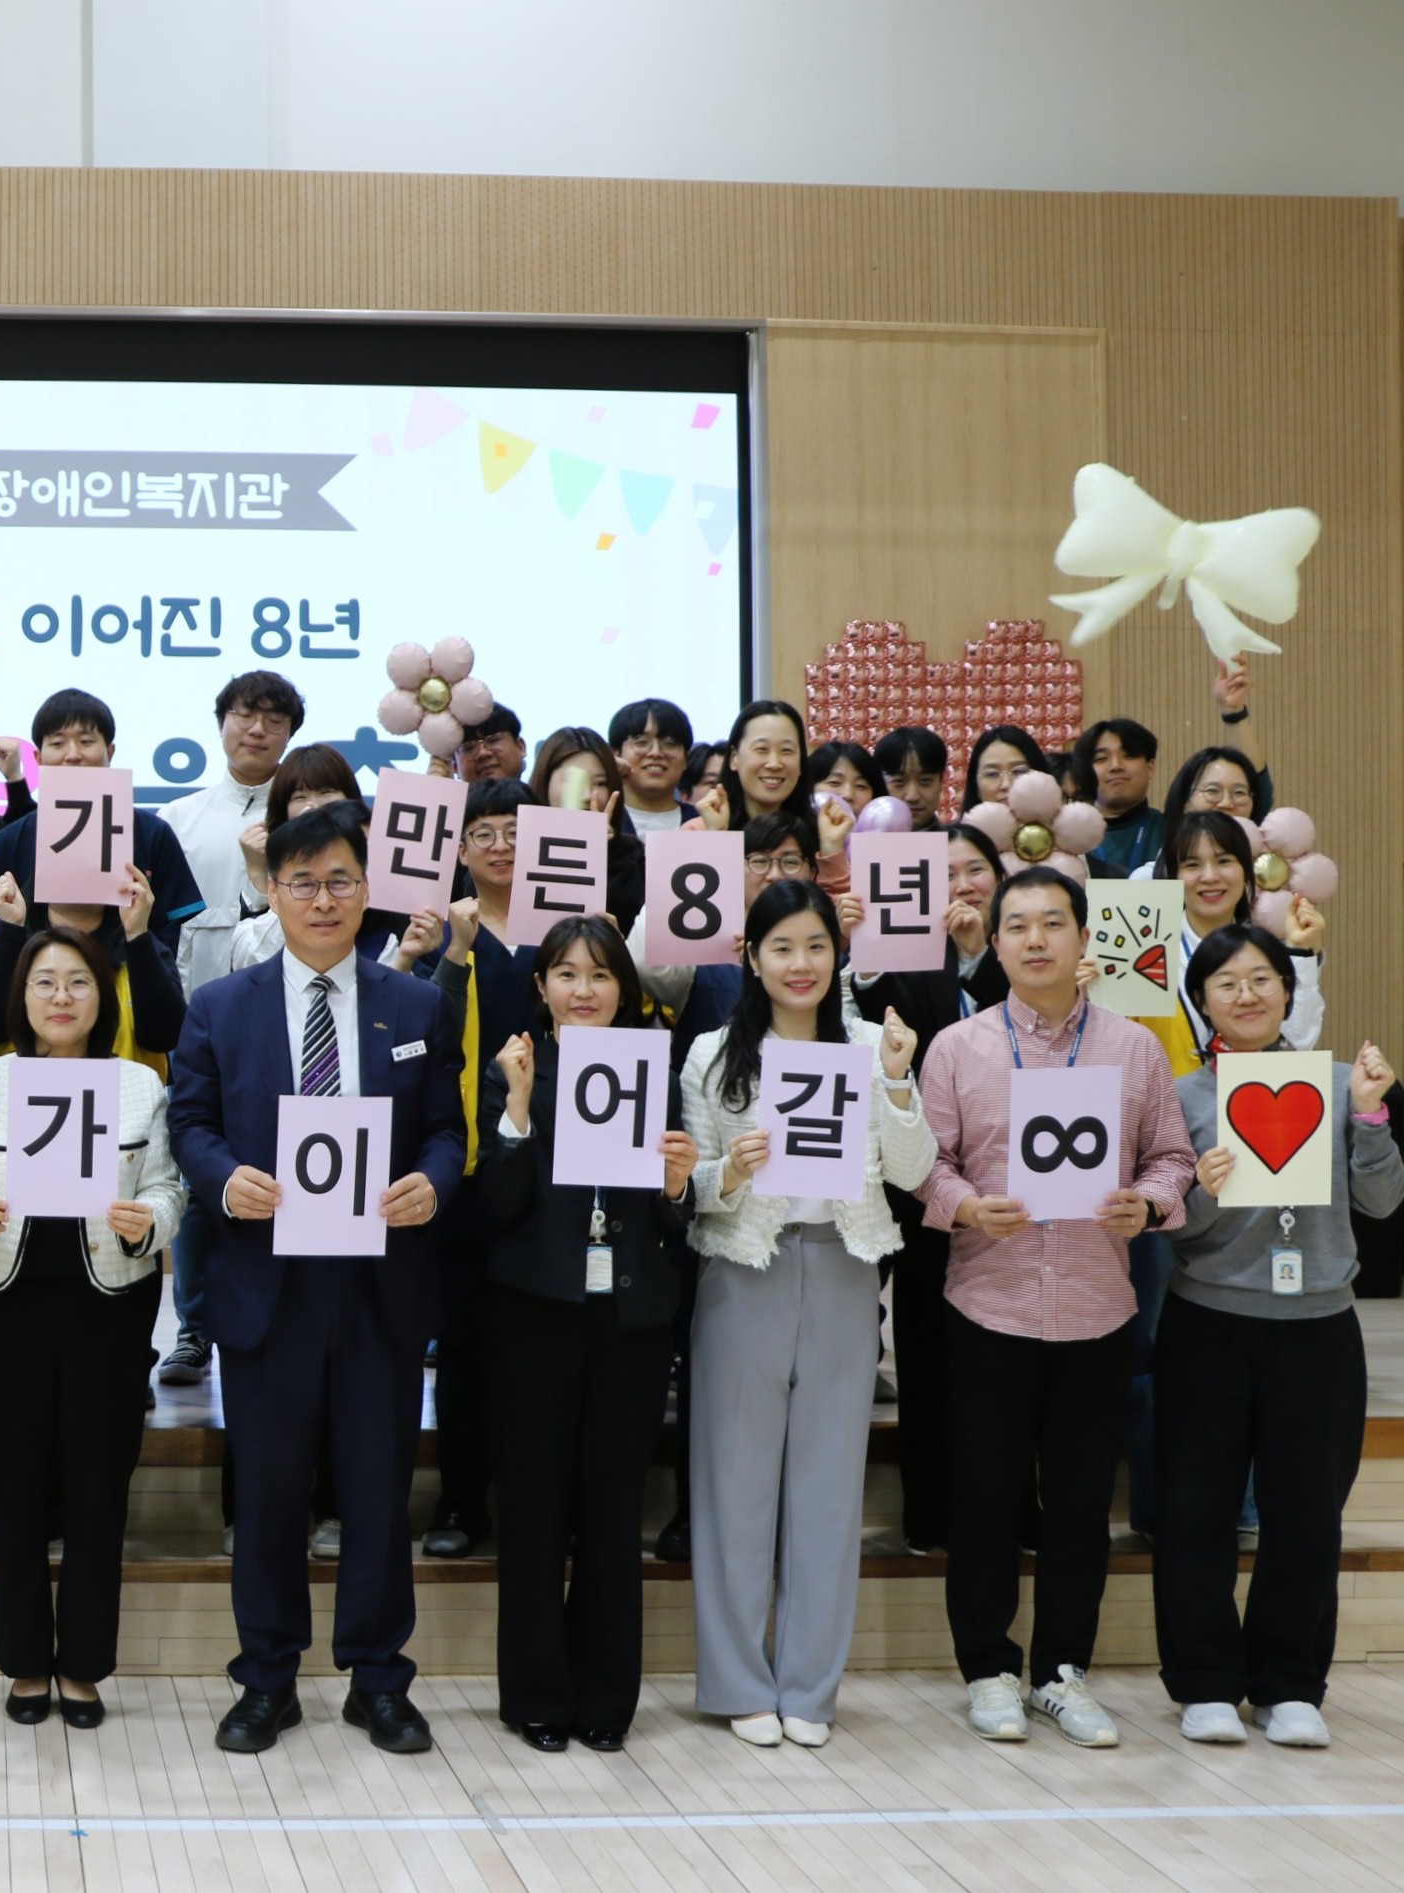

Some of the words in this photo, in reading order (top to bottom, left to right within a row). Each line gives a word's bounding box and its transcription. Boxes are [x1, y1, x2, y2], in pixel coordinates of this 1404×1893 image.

[21, 595, 222, 657] 이어진
[251, 597, 360, 659] 8년
[50, 795, 123, 873] 가
[386, 802, 454, 881] 만
[526, 836, 596, 913] 든
[667, 862, 722, 940] 8
[869, 859, 931, 935] 년
[23, 1089, 107, 1179] 가
[574, 1060, 649, 1148] 어
[776, 1072, 858, 1159] 갈
[295, 1127, 369, 1217] 이
